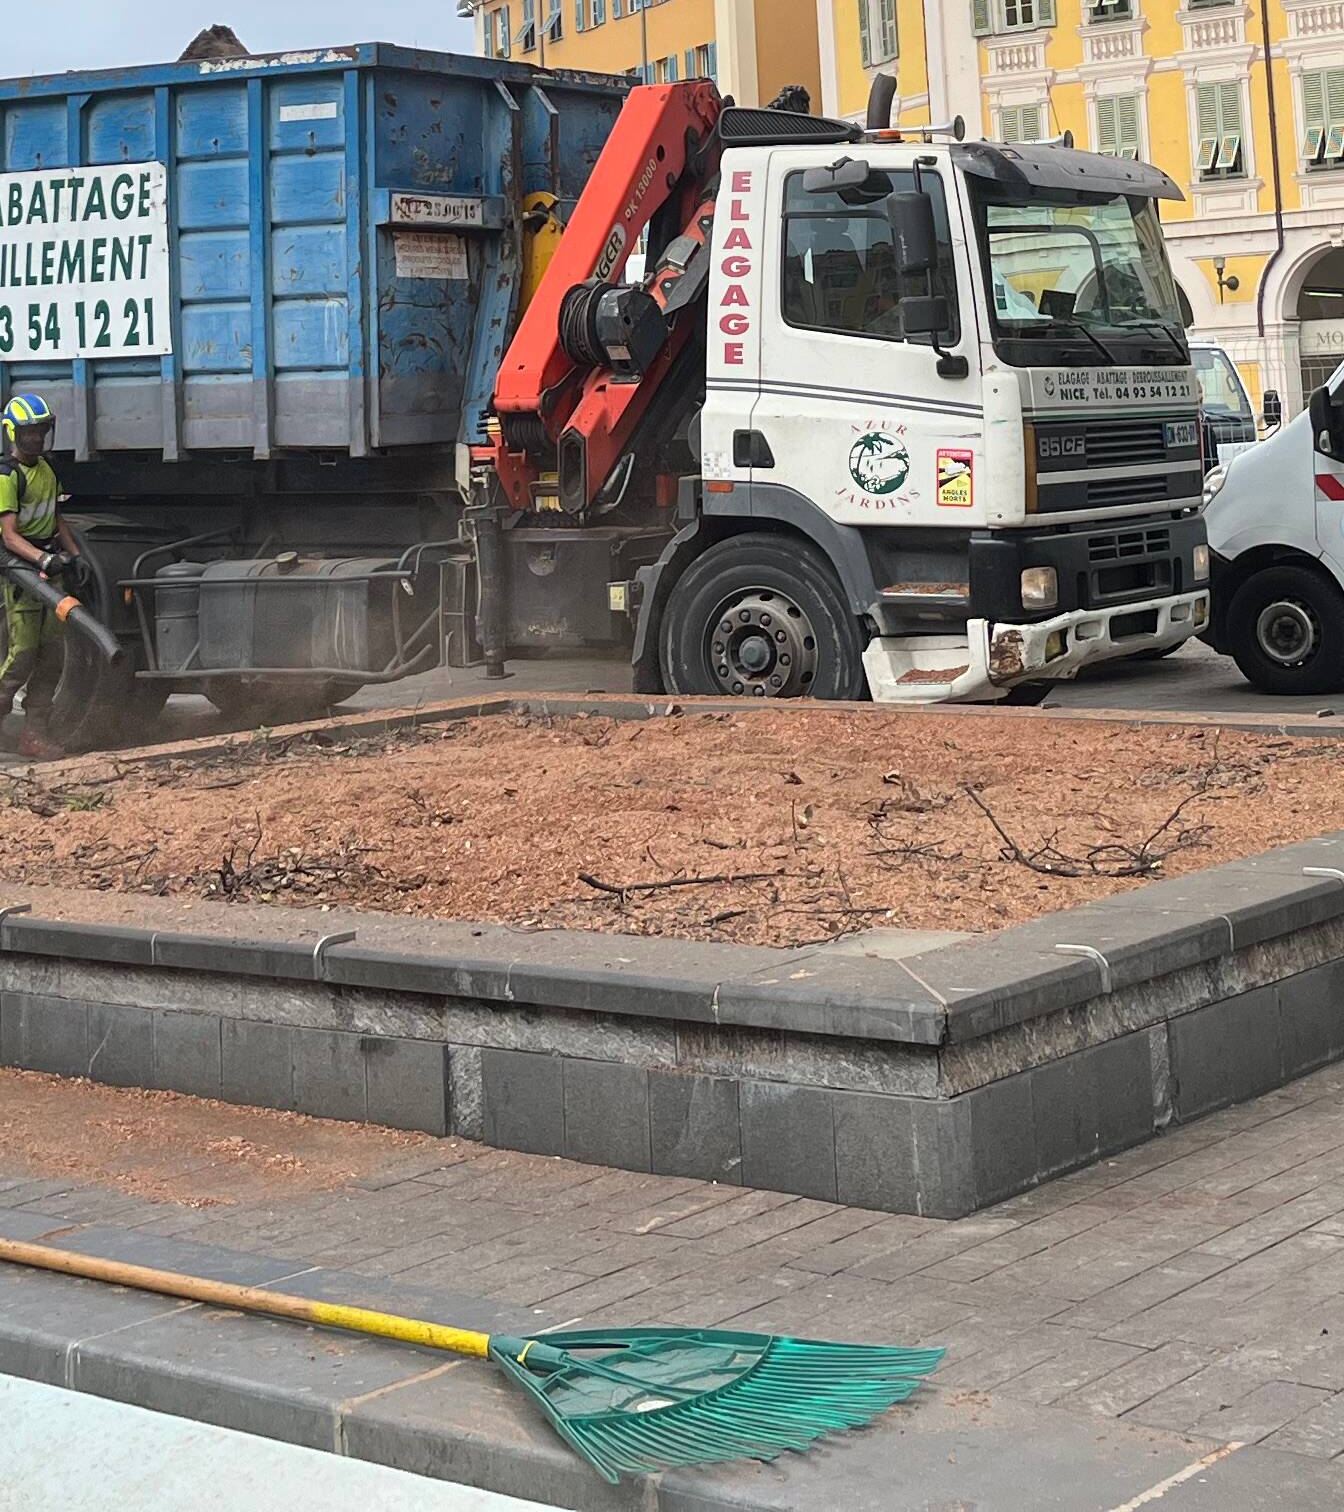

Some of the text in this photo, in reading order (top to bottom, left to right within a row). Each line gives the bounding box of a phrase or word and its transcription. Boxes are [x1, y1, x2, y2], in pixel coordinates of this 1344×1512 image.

[636, 159, 657, 201] 13000
[719, 171, 752, 364] ELAGAGE
[28, 302, 61, 351] 54
[75, 299, 111, 349] 12
[123, 297, 154, 347] 21
[1058, 372, 1090, 385] ELAGAGE
[1096, 371, 1128, 385] ABATTAGE
[1060, 388, 1090, 402] NICE,
[1116, 387, 1130, 399] 04
[1133, 386, 1146, 399] 93
[1150, 386, 1162, 398] 54
[1165, 385, 1177, 397] 12
[1180, 385, 1191, 397] 21
[851, 420, 907, 435] AZUR
[836, 488, 920, 509] JARDINS
